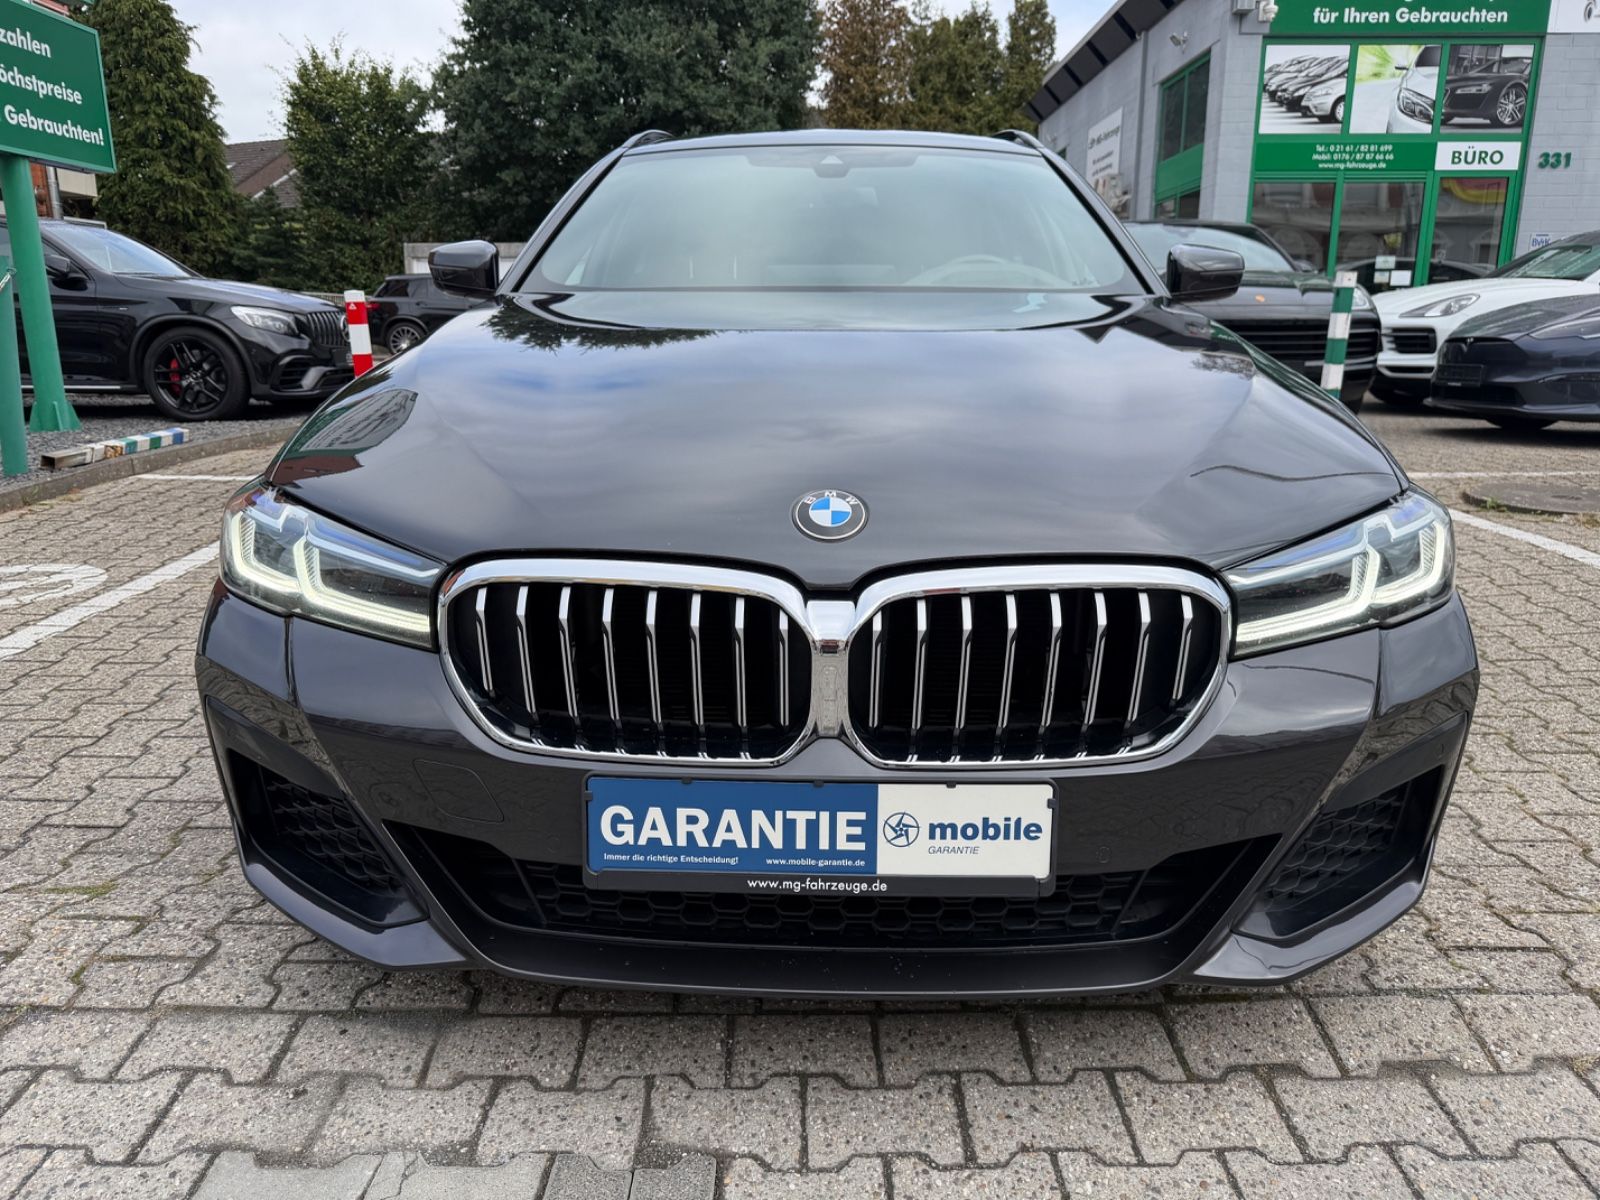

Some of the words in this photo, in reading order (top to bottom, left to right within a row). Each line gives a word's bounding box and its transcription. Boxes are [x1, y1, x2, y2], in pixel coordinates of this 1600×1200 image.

[1313, 7, 1339, 24] für
[1343, 7, 1390, 24] Ihren
[1395, 7, 1508, 24] Gebrauchten
[4, 104, 104, 146] Gebrauchten!
[1451, 146, 1504, 165] BÜRO
[1538, 152, 1572, 169] 331
[803, 490, 859, 505] BMW
[600, 804, 866, 851] GARANTIE
[928, 817, 1043, 841] mobile
[603, 853, 630, 862] Immer
[632, 853, 645, 862] die
[647, 853, 678, 864] richtige
[680, 855, 739, 865] Entscheidung!
[928, 846, 980, 855] GARANTIE
[766, 857, 866, 868] www.mobile-garantie.de
[747, 878, 888, 894] www.mg-fahrzeuge.de
